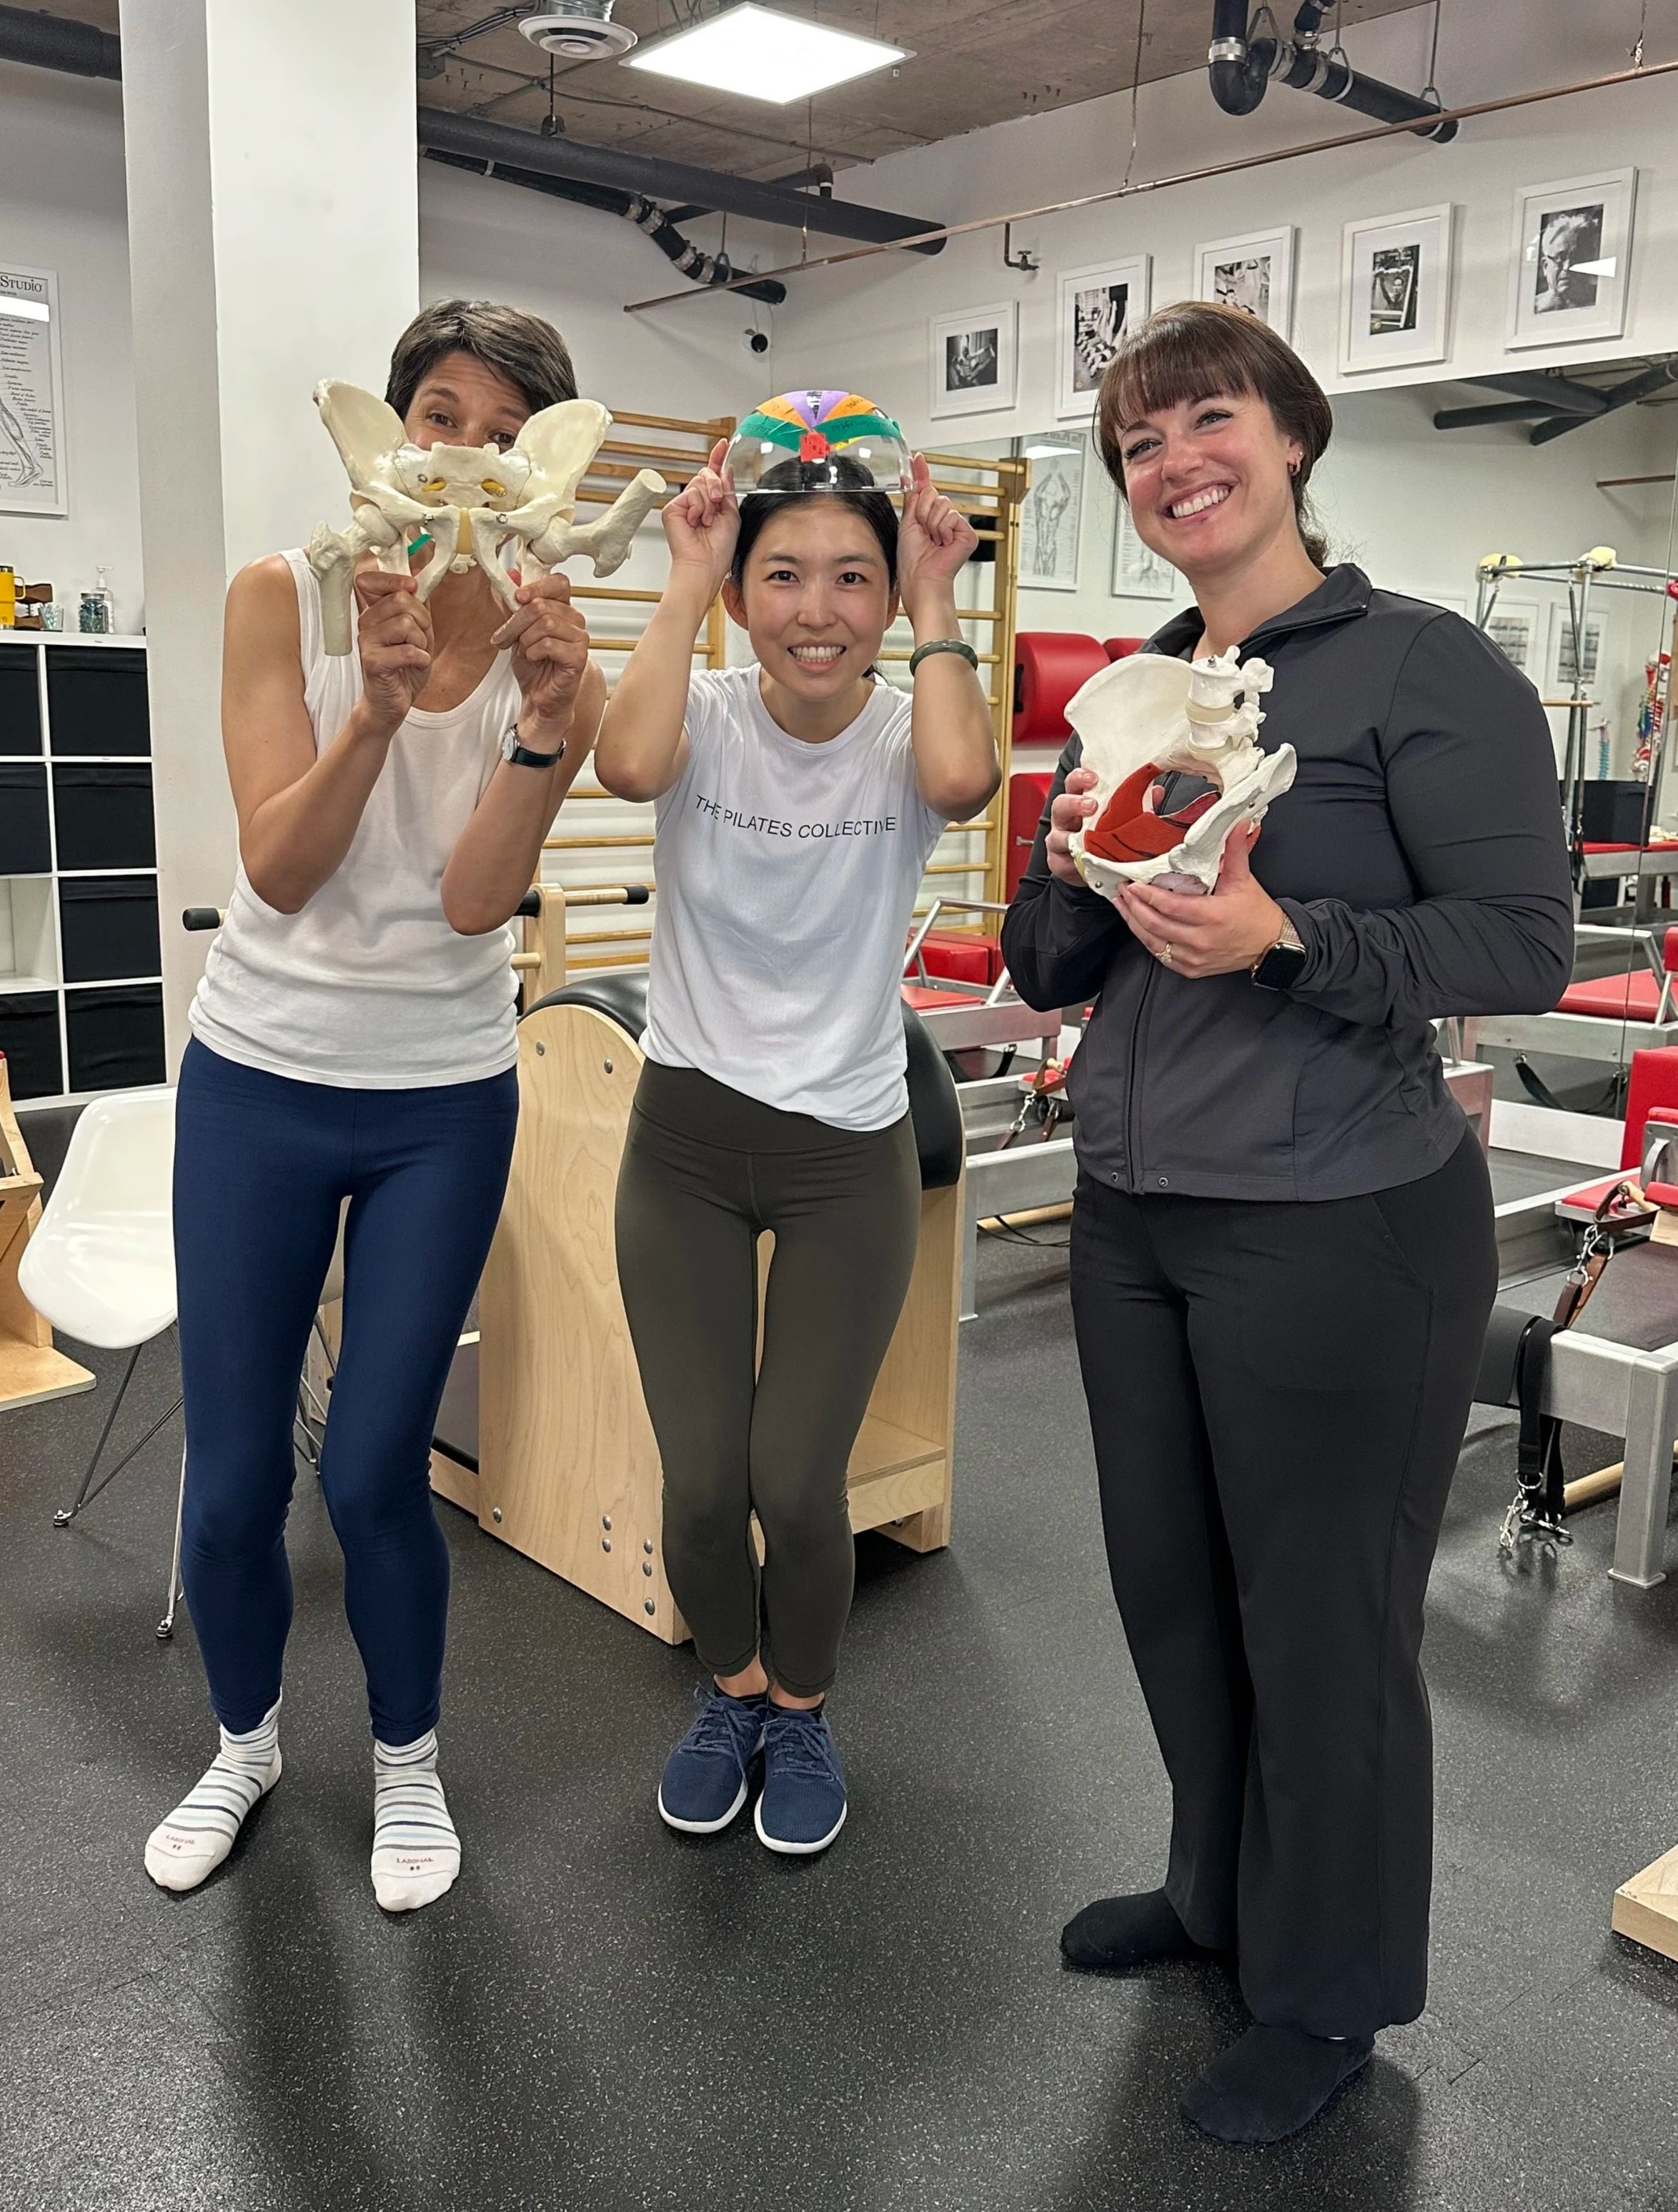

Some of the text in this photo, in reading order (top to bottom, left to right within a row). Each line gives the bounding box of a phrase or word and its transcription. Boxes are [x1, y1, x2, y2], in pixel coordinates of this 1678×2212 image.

[695, 794, 897, 839] THE PILATES COLLECTIVE
